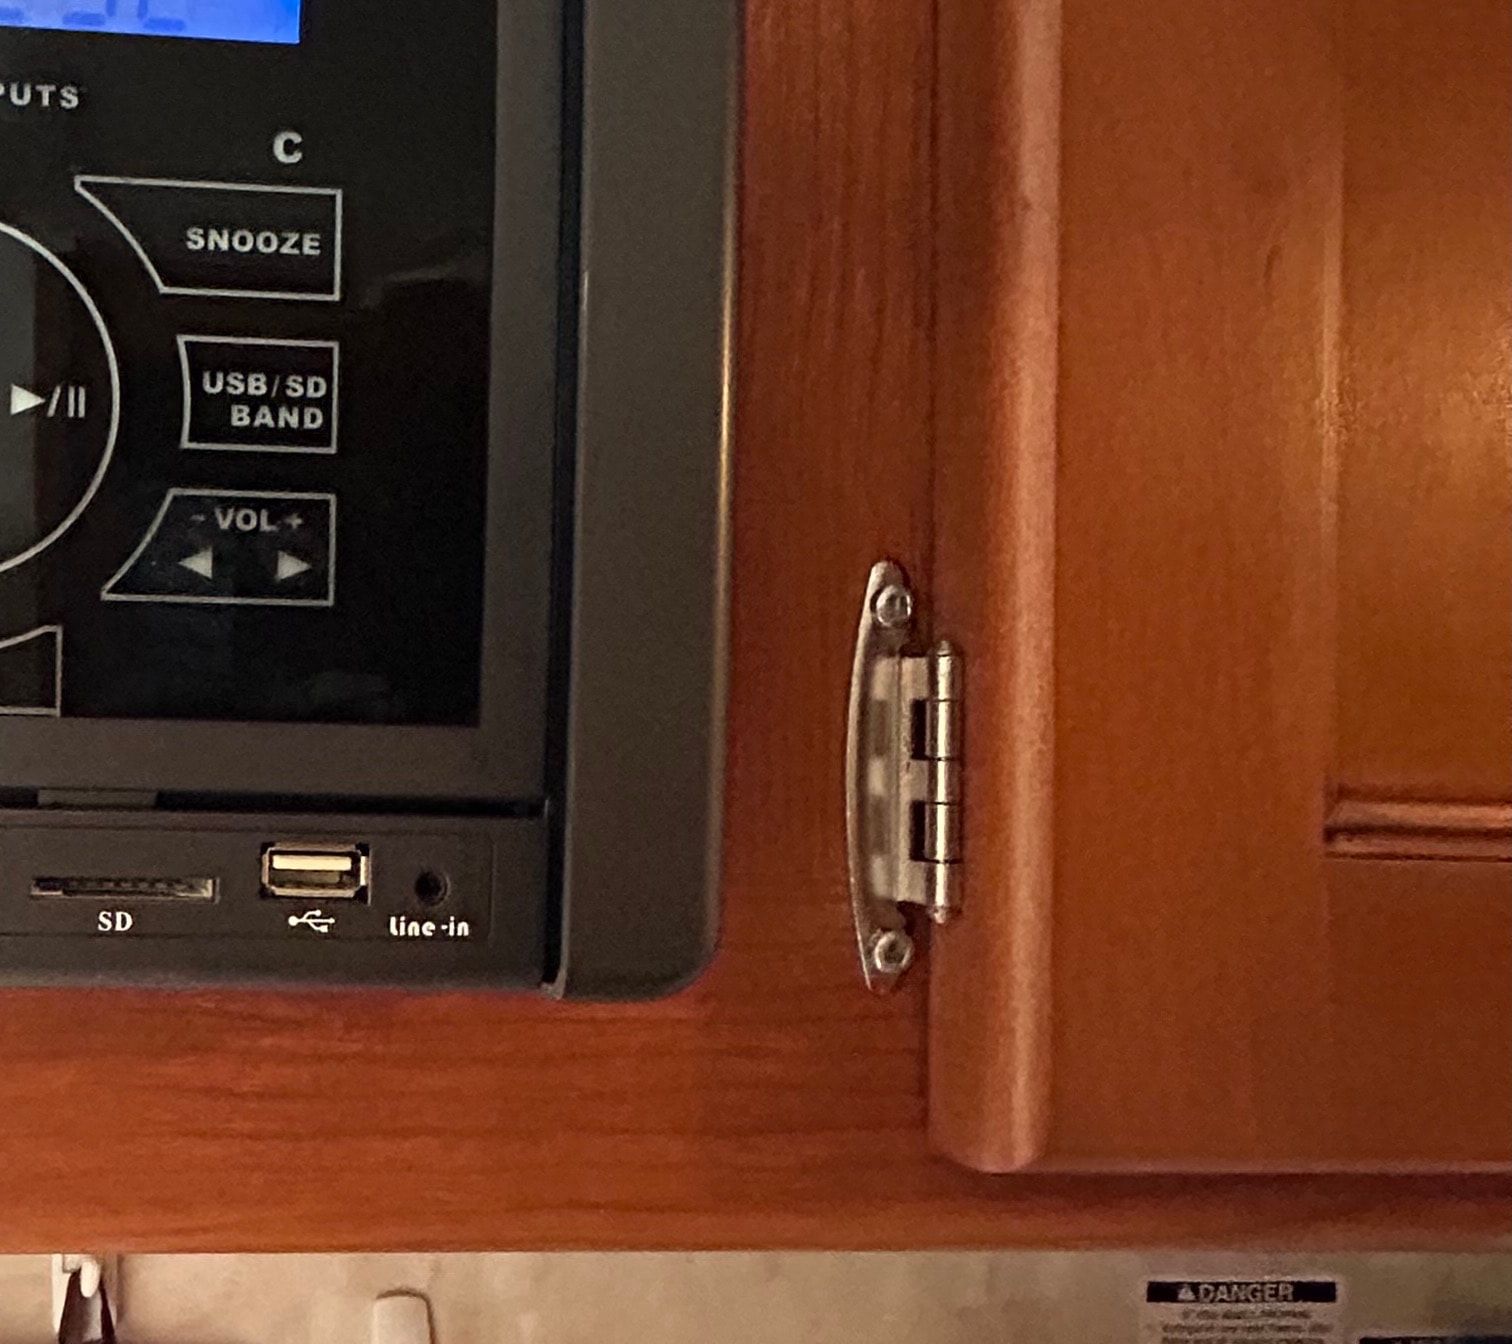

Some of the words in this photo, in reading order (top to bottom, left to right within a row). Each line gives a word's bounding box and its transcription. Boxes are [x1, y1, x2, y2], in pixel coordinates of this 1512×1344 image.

[271, 132, 304, 167] C
[185, 227, 323, 257] SNOOZE
[201, 371, 329, 402] USB/SD
[229, 402, 324, 432] BAND
[214, 507, 279, 533] VOL
[97, 911, 133, 932] SD
[1197, 1282, 1294, 1303] DANGER
